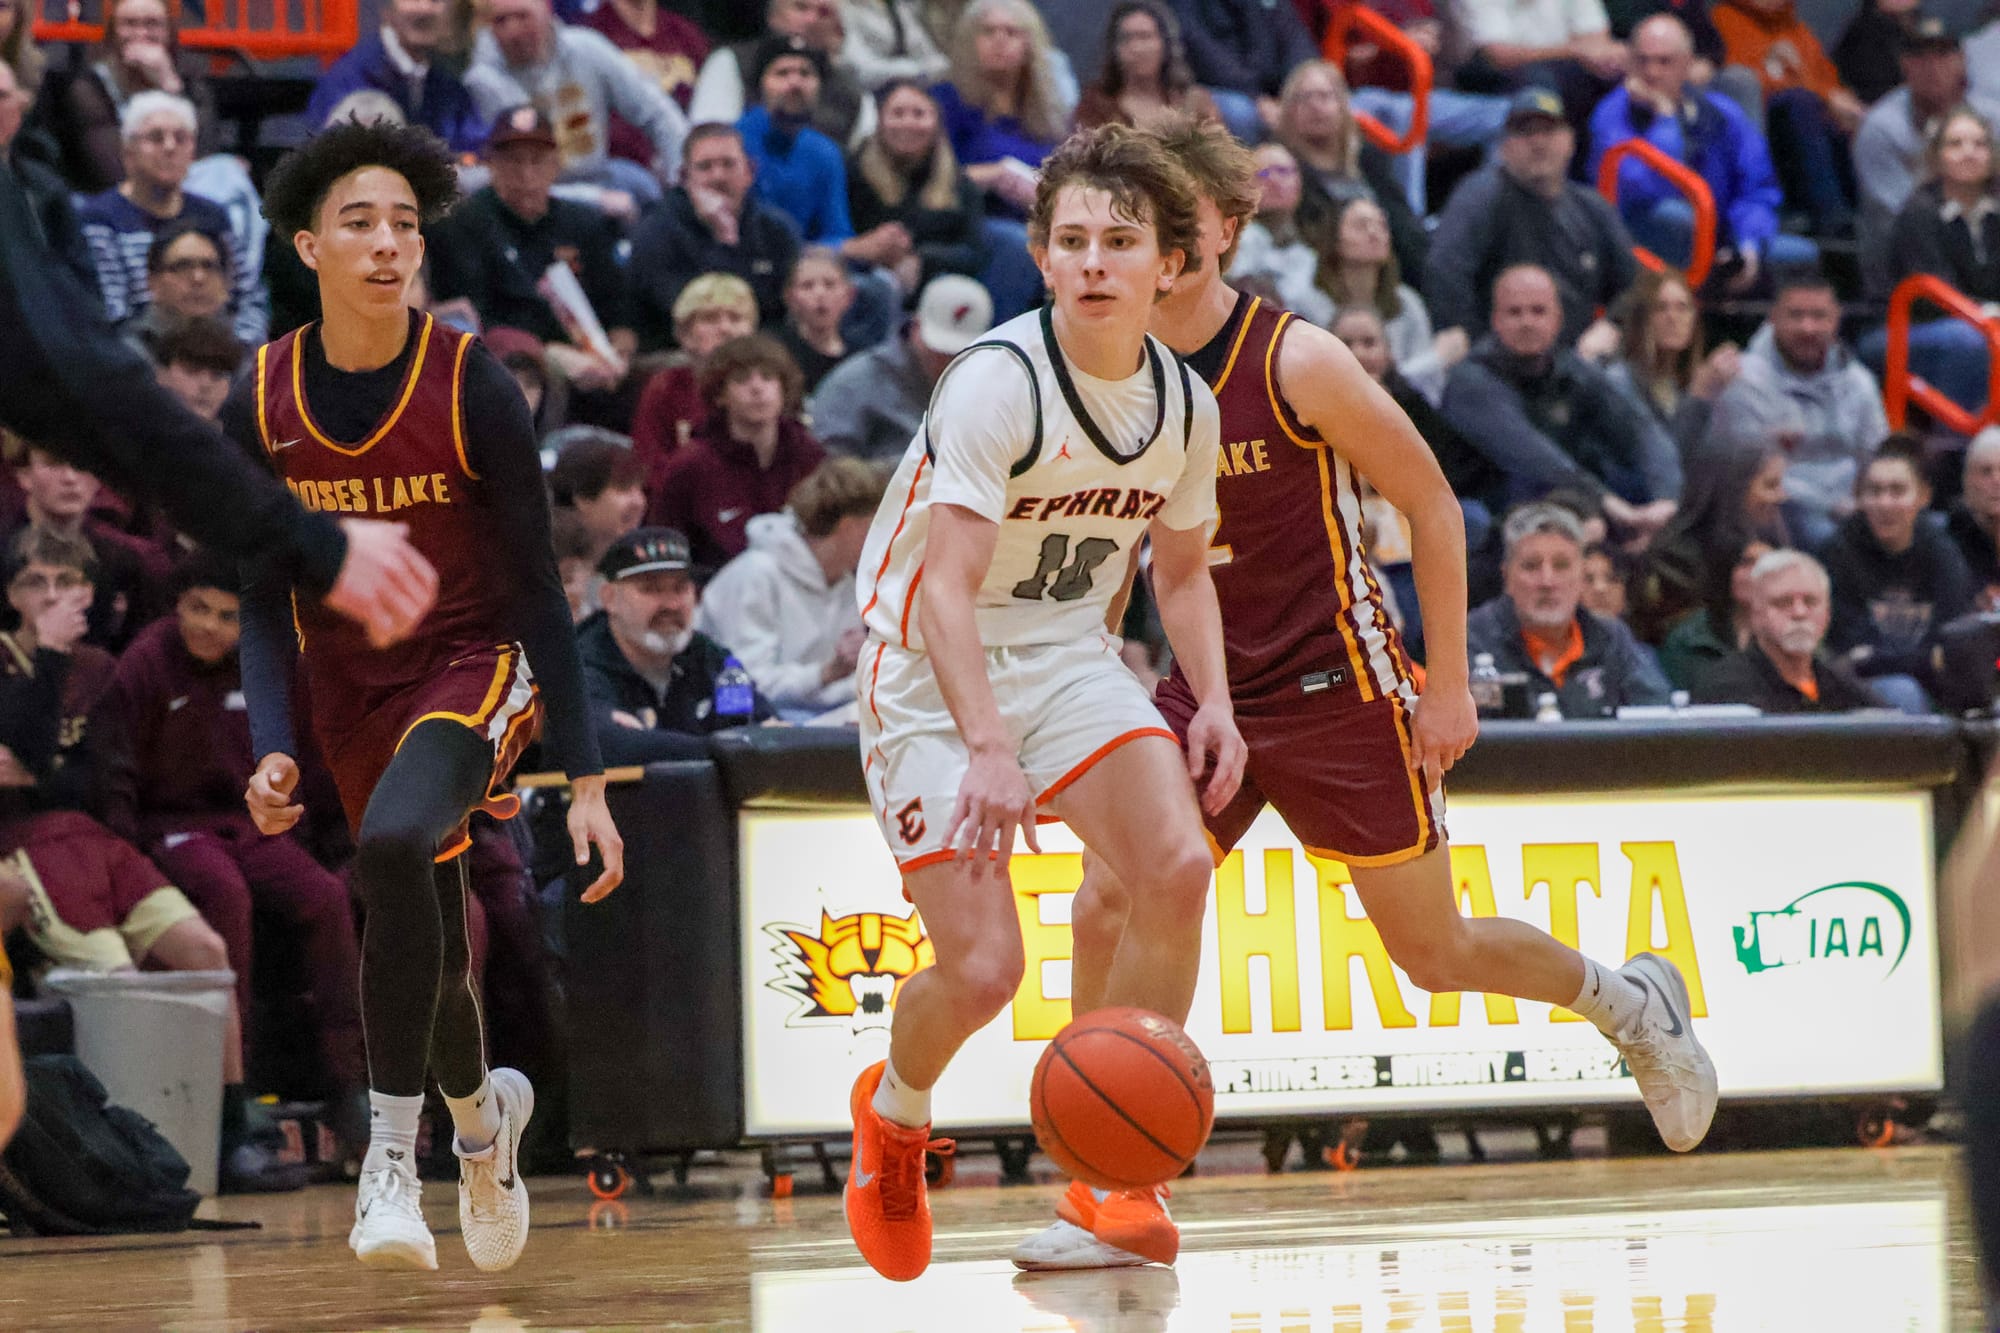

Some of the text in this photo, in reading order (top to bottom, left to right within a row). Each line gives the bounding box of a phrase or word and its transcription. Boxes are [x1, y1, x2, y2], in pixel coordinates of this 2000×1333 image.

[1216, 439, 1271, 477] AKE
[373, 473, 451, 513] LAKE
[1010, 840, 1709, 1041] EHRATA
